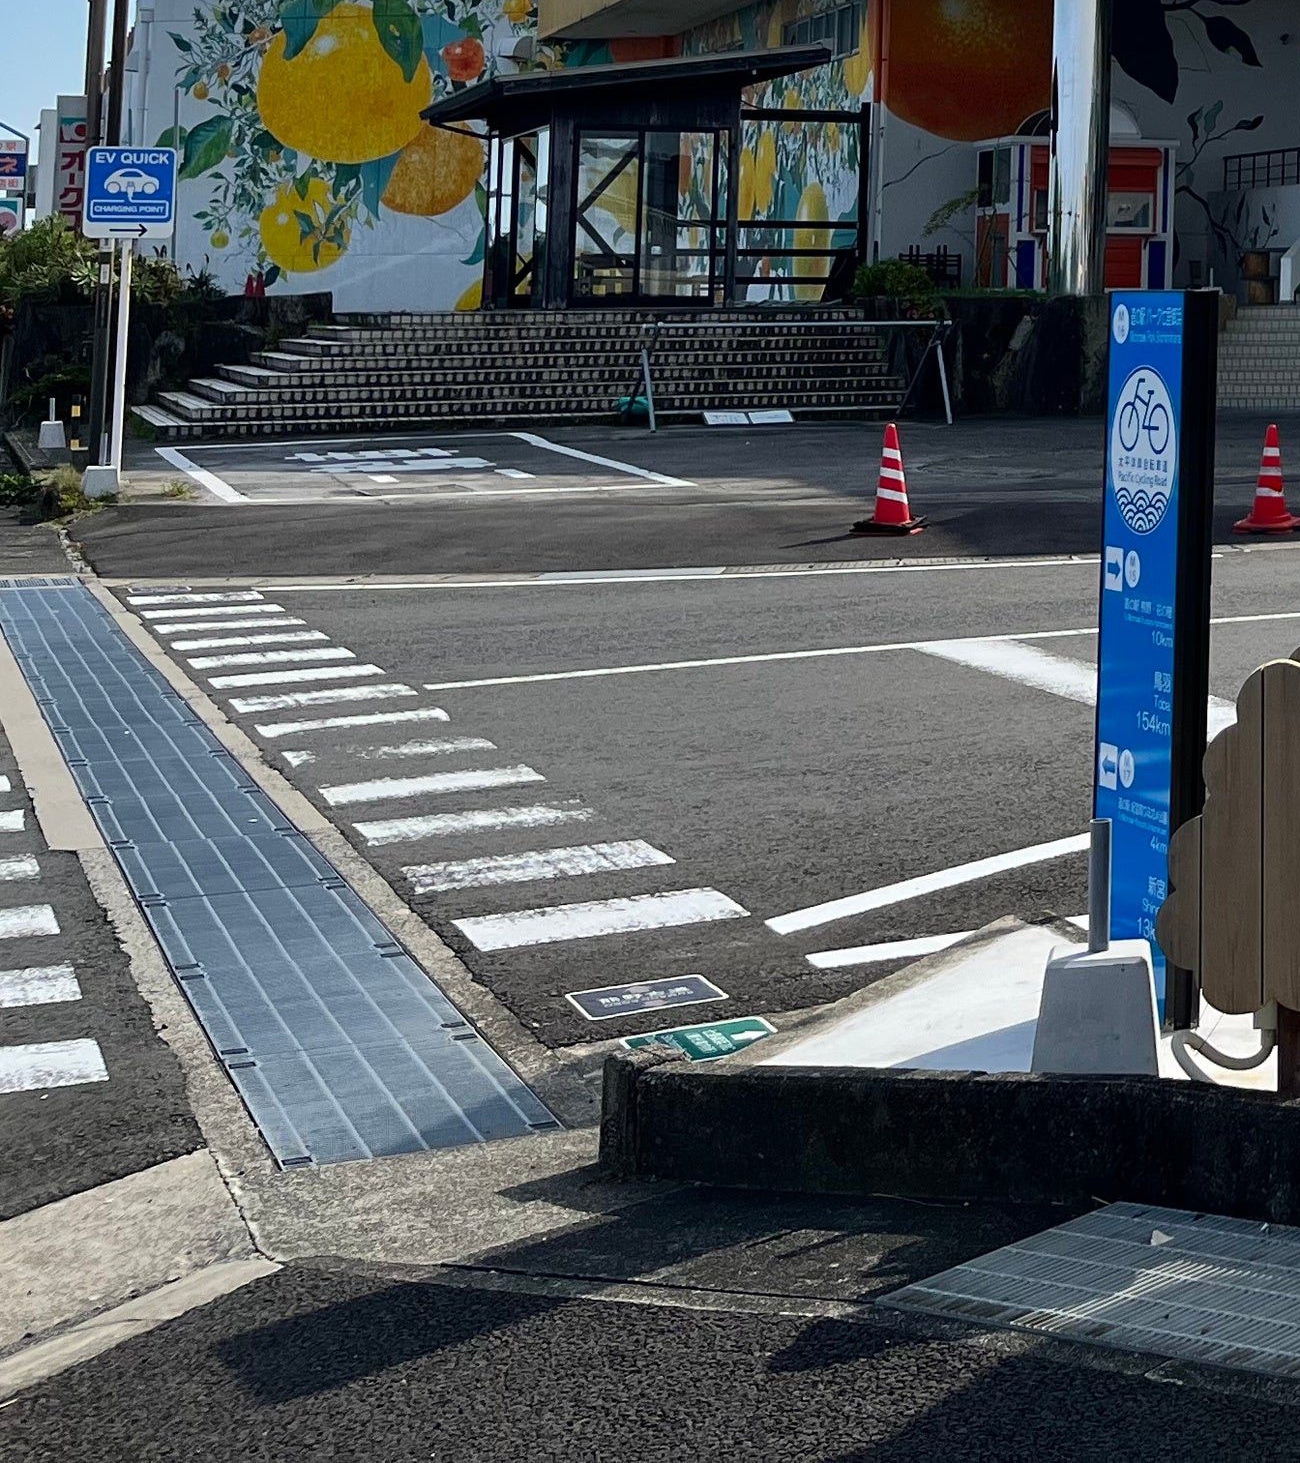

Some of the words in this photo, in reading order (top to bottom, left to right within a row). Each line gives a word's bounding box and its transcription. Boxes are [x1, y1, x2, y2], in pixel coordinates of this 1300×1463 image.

[95, 152, 116, 164] EV
[120, 152, 169, 165] QUICK
[94, 205, 138, 214] CHARGING
[139, 206, 165, 214] POINT
[1136, 710, 1171, 736] 154km
[1137, 916, 1157, 941] 13k
